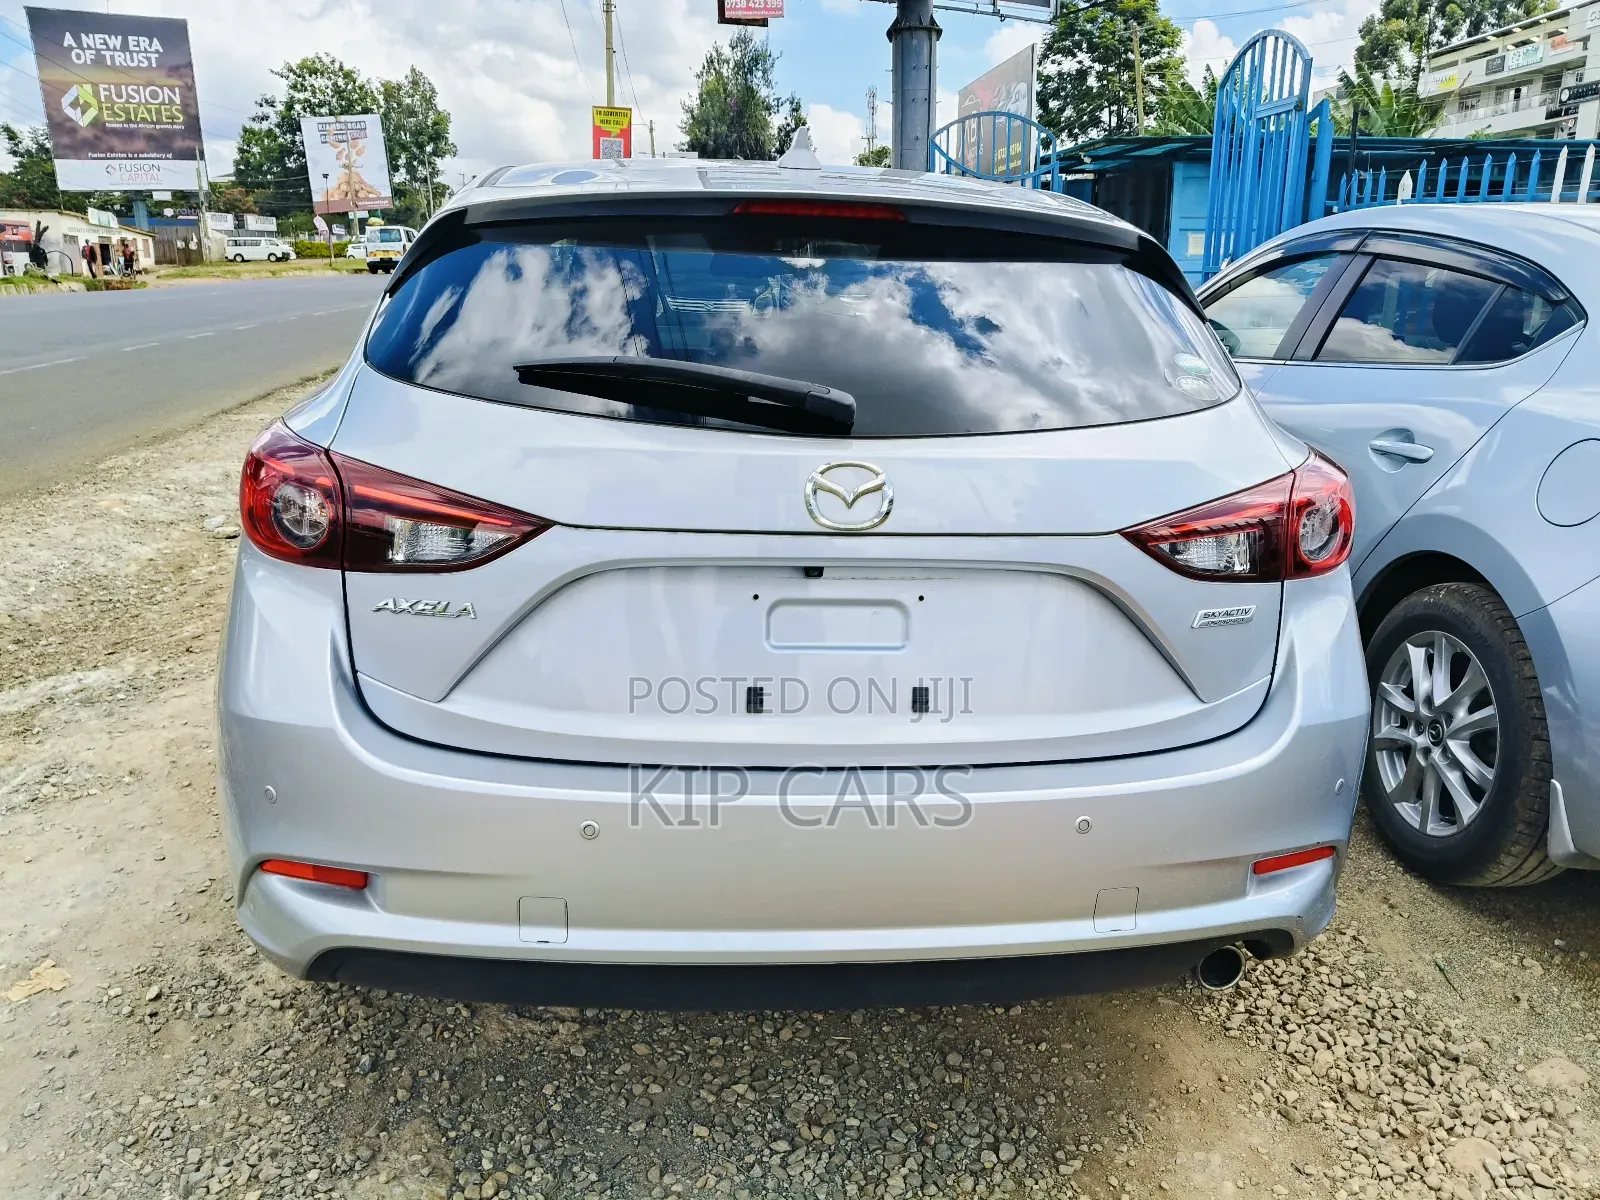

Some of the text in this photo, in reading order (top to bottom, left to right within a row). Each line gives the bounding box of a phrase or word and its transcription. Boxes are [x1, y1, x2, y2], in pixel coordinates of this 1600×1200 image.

[726, 0, 782, 8] 0738 423 399
[63, 32, 163, 52] A NEW ERA
[71, 50, 159, 68] OF TRUST
[98, 84, 180, 104] FUSION
[102, 104, 184, 123] ESTATES
[603, 110, 629, 118] ADVERTISE
[347, 122, 365, 130] ROAD
[118, 163, 161, 172] FUSION
[120, 173, 162, 182] CAPITAL
[370, 597, 477, 619] AXELA
[1202, 608, 1252, 618] SKYACTIV
